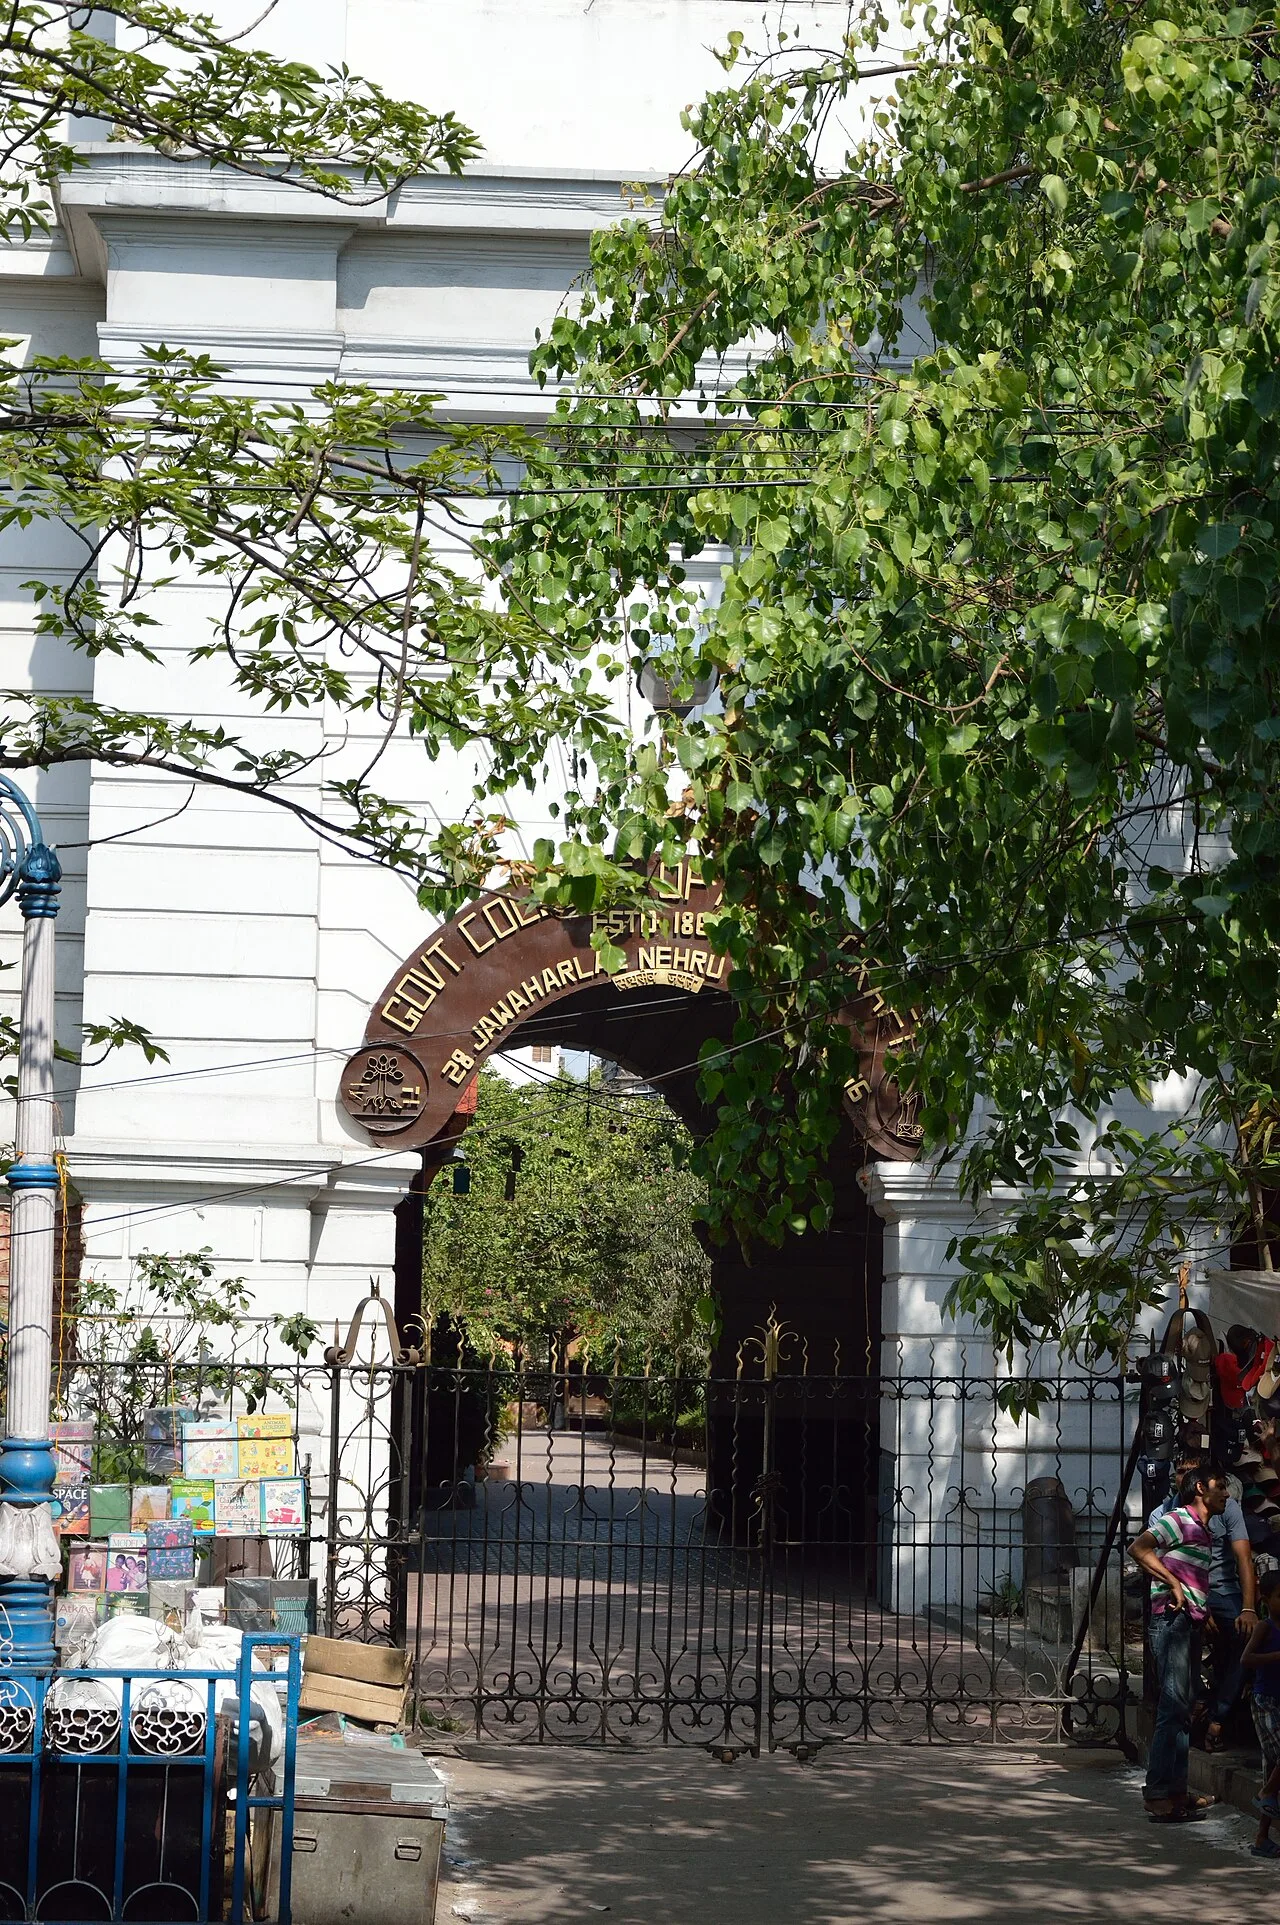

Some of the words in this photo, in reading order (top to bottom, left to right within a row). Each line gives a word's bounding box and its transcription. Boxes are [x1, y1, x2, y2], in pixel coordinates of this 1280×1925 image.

[673, 911, 706, 935] 186
[471, 951, 629, 1051] JAWAHARL
[638, 945, 726, 980] NEHRU
[52, 1488, 88, 1500] SPACE
